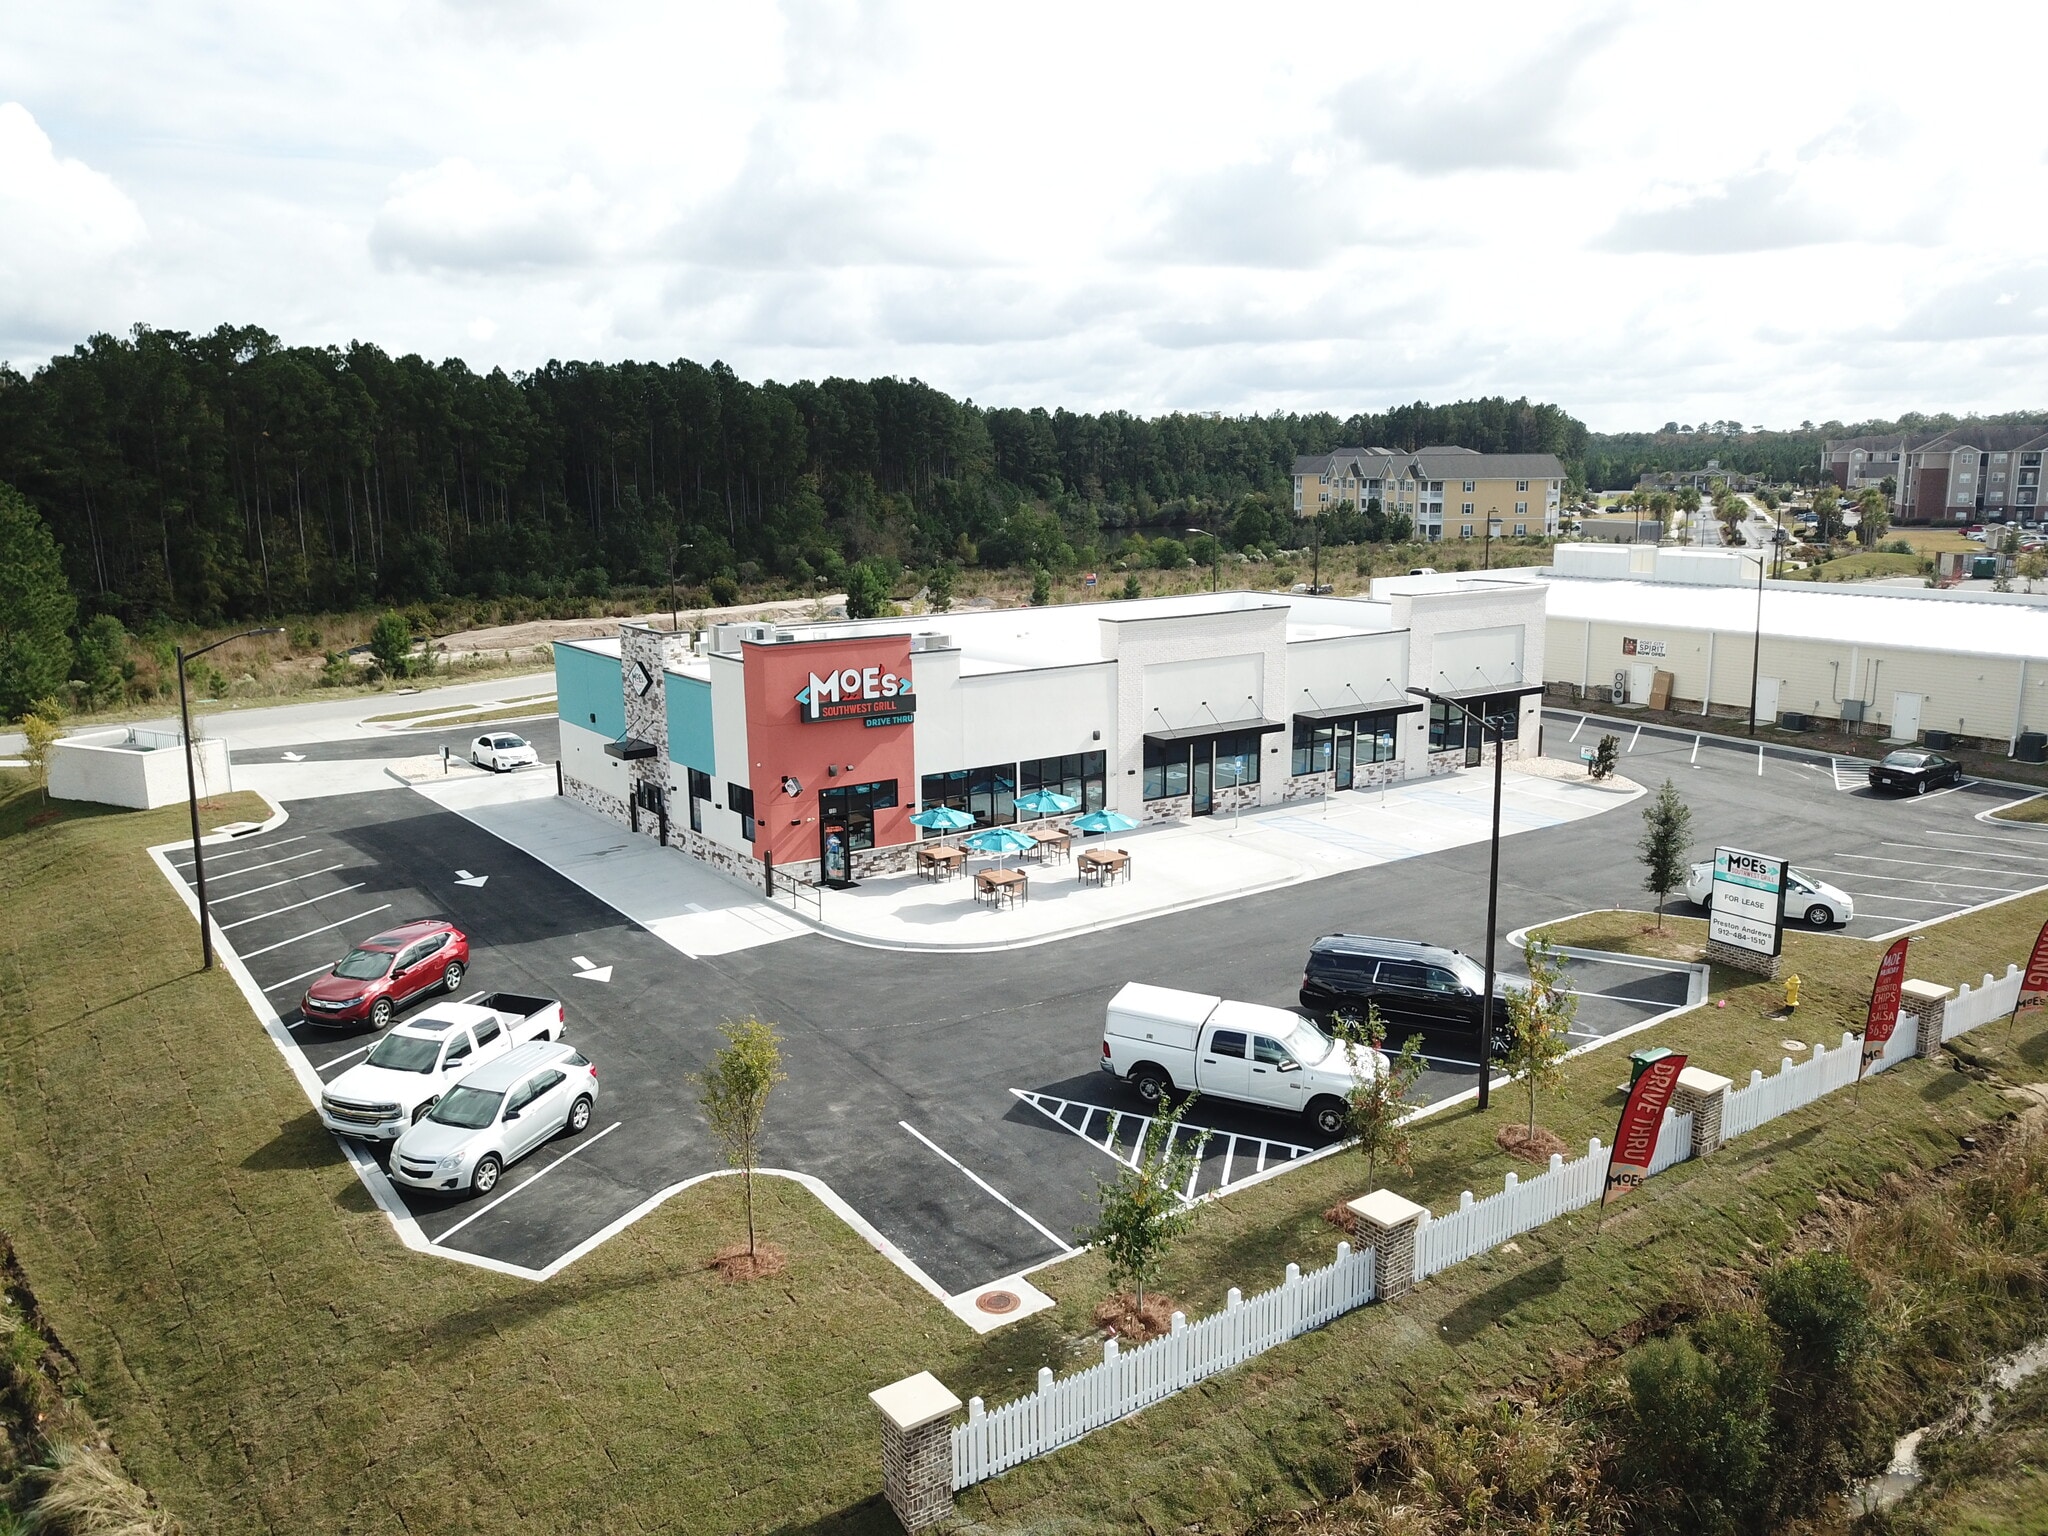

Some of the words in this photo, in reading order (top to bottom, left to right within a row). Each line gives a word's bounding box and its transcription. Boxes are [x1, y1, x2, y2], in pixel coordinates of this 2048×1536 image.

[1640, 644, 1665, 652] SPIRIT
[822, 703, 872, 717] SOUTHWEST
[873, 700, 897, 712] GRILL
[866, 717, 891, 727] DRIVE
[891, 714, 913, 725] THRU
[1724, 894, 1739, 903] FOR
[1741, 898, 1765, 910] LEASE
[1713, 918, 1740, 930] Preston
[1741, 924, 1772, 939] Andrews
[1717, 928, 1766, 945] 912-484-1510
[1884, 953, 1902, 966] MOE
[1874, 992, 1896, 1004] CHIPS
[1871, 1011, 1895, 1022] SALSA
[1636, 1062, 1675, 1114] DRIVE
[1624, 1117, 1655, 1160] THRU
